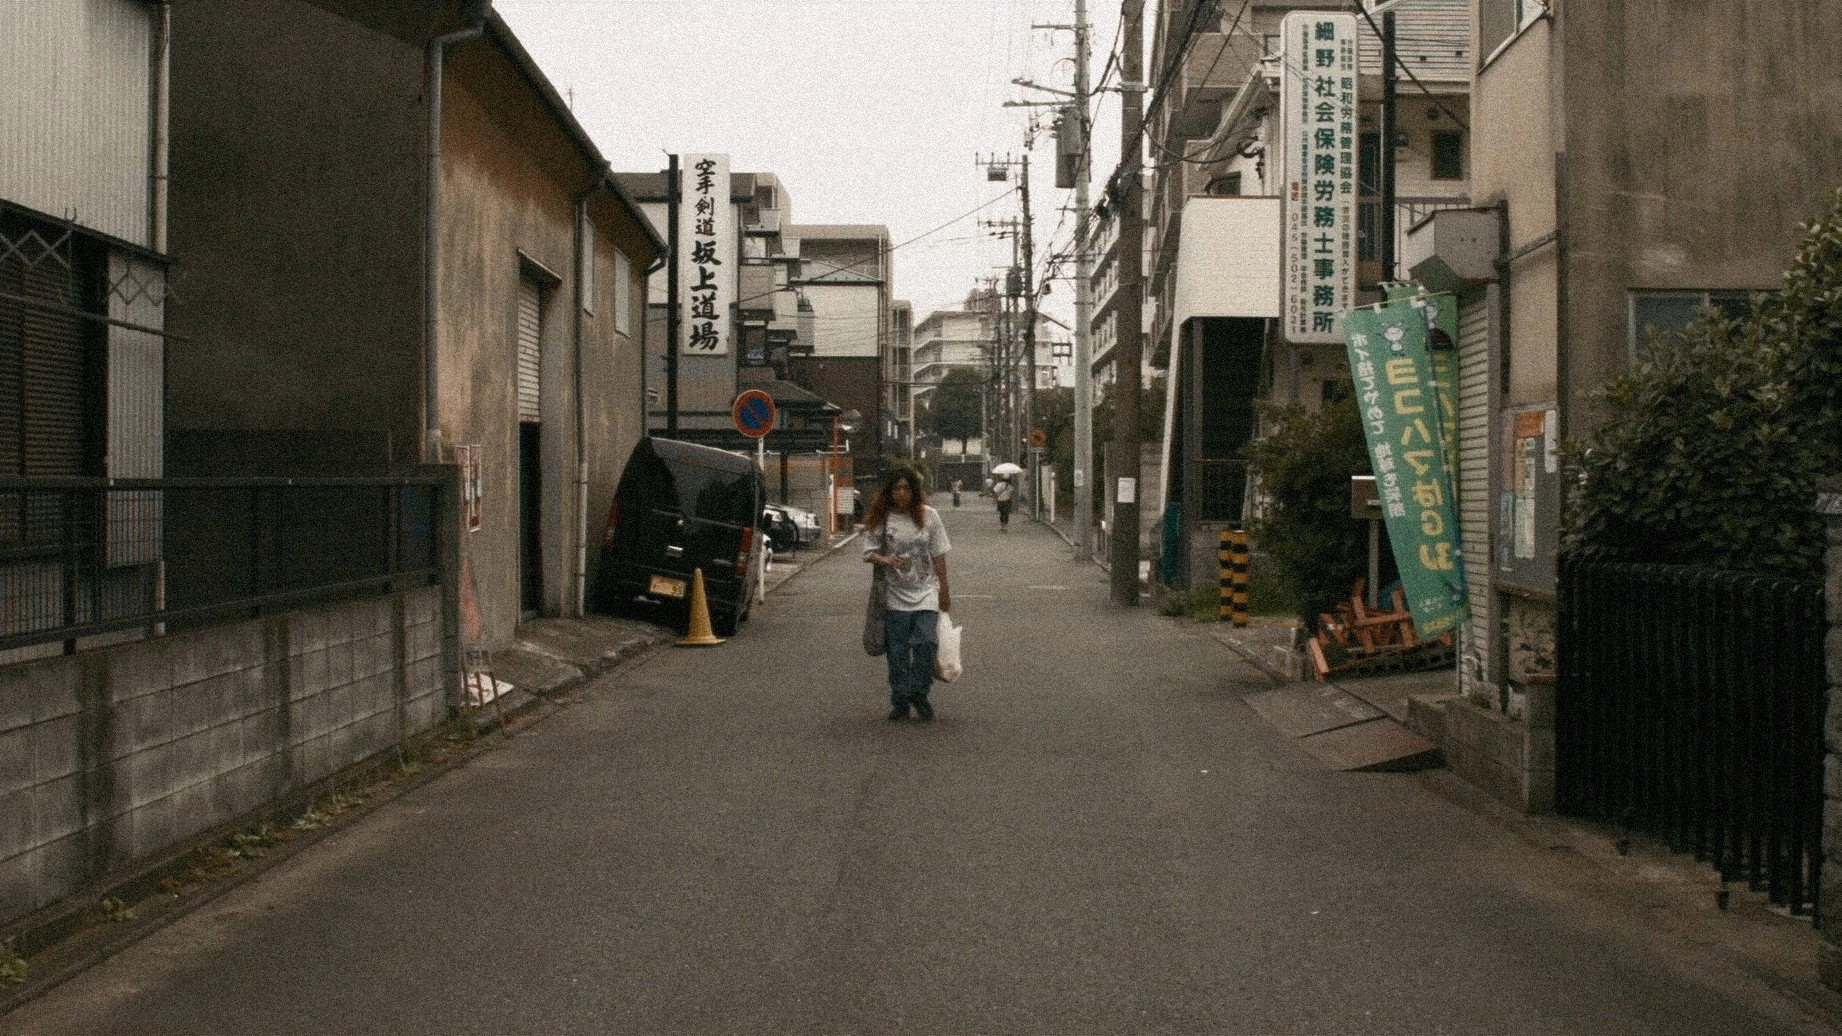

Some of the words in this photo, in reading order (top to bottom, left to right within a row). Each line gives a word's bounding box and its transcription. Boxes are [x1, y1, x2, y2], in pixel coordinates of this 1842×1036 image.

[1314, 22, 1335, 333] 細野社会保険労務士事務所
